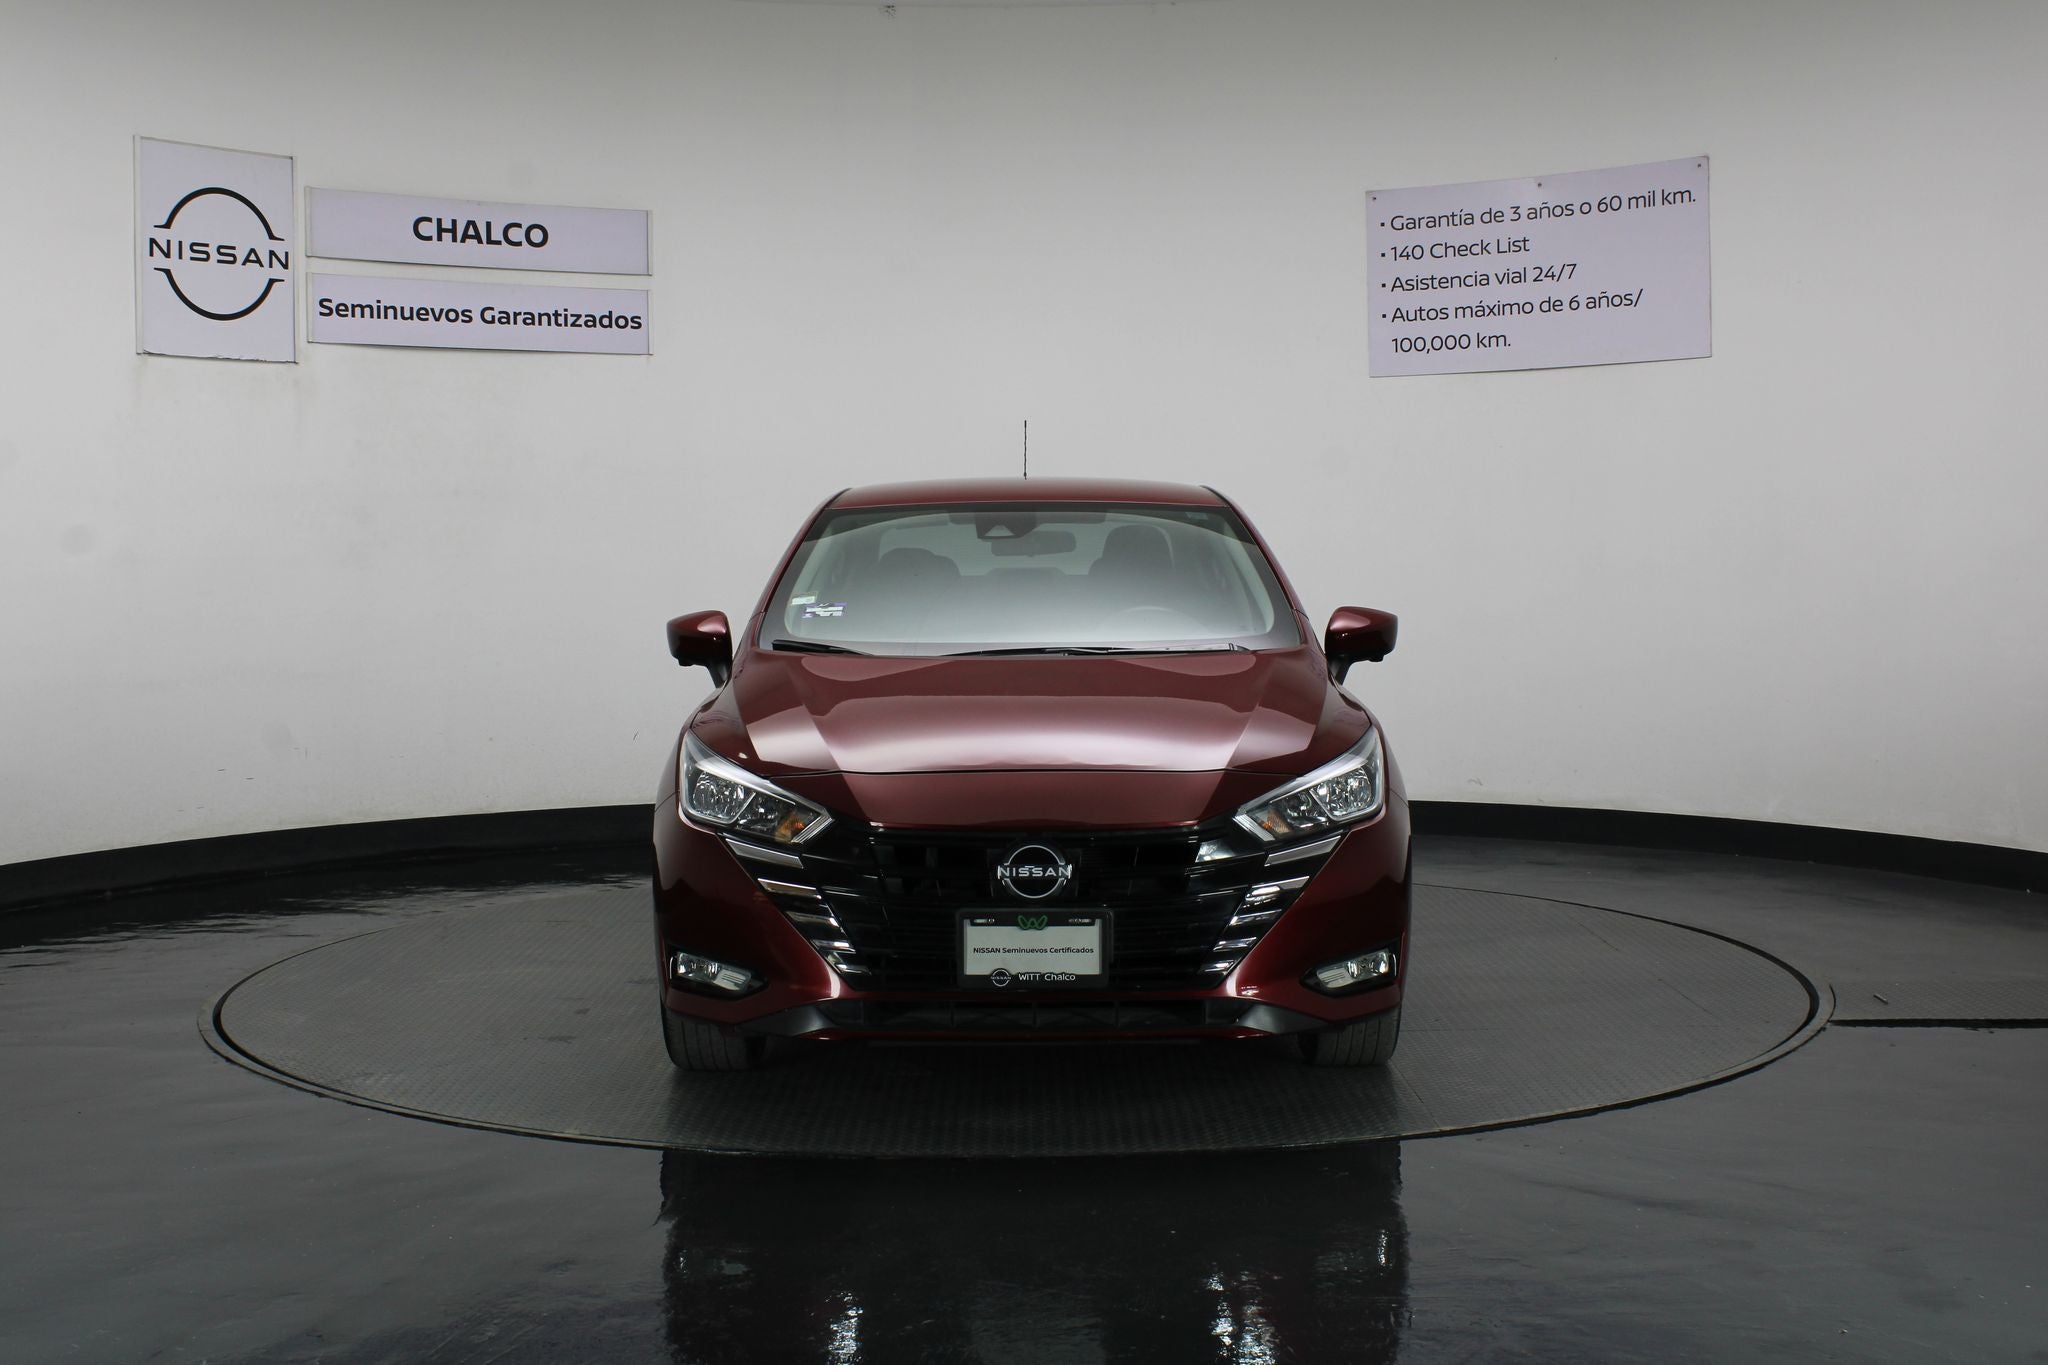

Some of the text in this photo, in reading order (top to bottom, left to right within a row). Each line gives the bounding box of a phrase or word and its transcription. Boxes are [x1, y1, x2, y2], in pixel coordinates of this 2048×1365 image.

[1390, 187, 1697, 232] Garantía de 3 años o 60 mil km.
[412, 216, 549, 249] CHALCO
[149, 237, 289, 271] NISSAN
[1390, 236, 1531, 262] 140 Check List
[1390, 263, 1578, 293] Asistencia vial 24/7
[318, 297, 643, 330] Seminuevos Garantizados
[1391, 288, 1644, 323] Autos máximo de 6 años/
[1391, 332, 1511, 355] 100,000 km.
[999, 866, 1070, 878] NISSAN
[1002, 946, 1048, 954] Seminuevos
[1049, 946, 1094, 954] Certificados
[1018, 973, 1040, 981] WITT
[1044, 973, 1076, 981] Chalco
